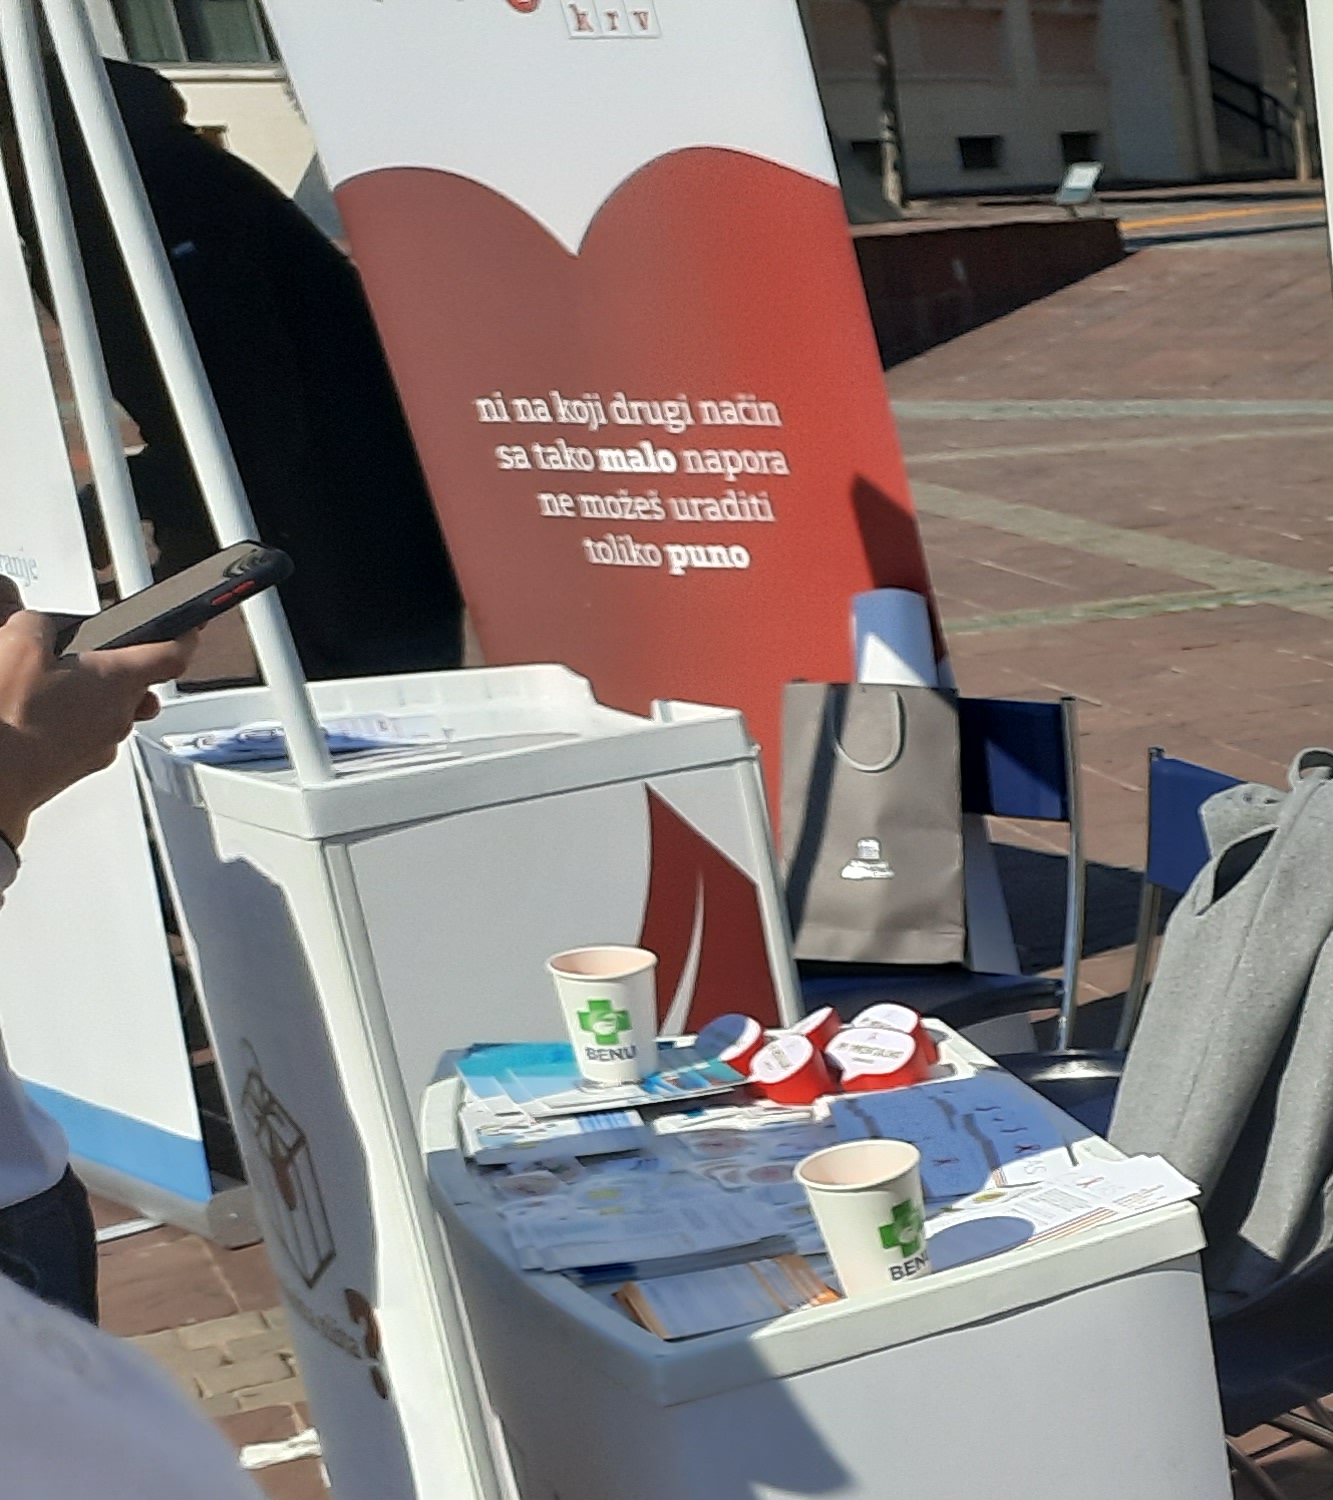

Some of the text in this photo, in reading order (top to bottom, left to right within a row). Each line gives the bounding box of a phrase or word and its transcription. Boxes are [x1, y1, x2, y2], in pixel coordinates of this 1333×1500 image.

[475, 390, 782, 433] ni na koji drugi način
[496, 438, 790, 482] sa tako malo napora
[537, 488, 776, 522] ne možeš uraditi
[582, 532, 750, 576] toliko puno
[585, 1045, 637, 1062] BENU
